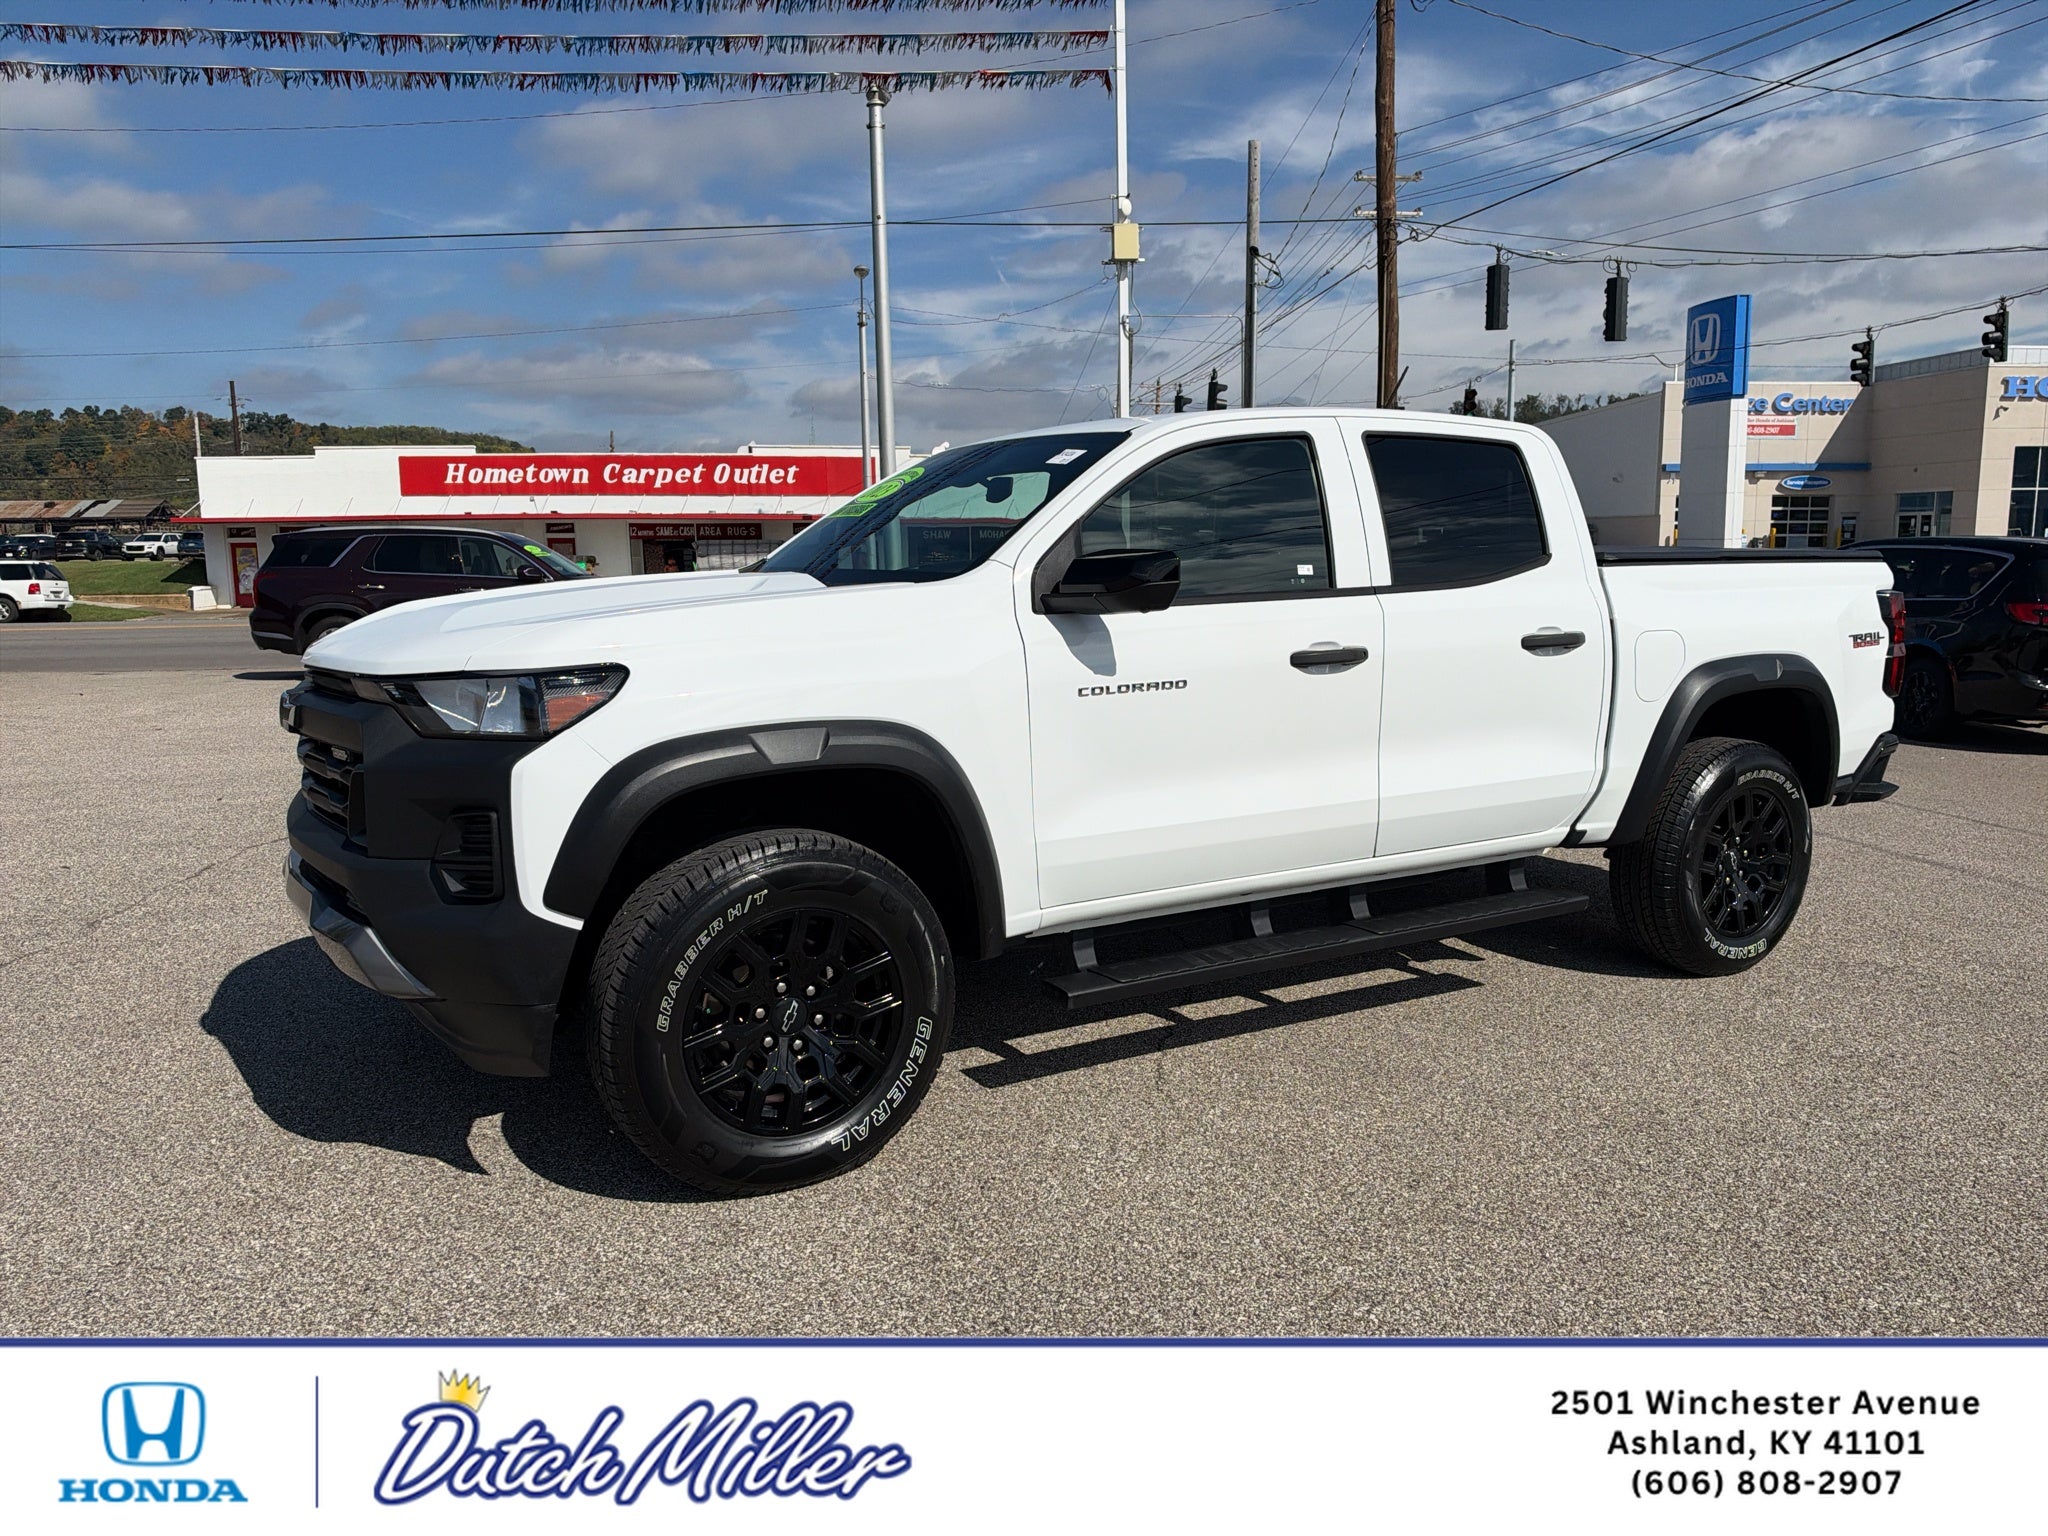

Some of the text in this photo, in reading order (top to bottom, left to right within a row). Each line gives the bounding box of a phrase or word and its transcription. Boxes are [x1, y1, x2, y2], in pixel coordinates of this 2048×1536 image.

[1774, 392, 1856, 413] Center
[444, 463, 799, 489] Hometown Carpet Outlet
[656, 526, 674, 536] SAME
[679, 526, 694, 536] CASH
[700, 526, 756, 536] AREA RUGS
[922, 530, 951, 540] SHAW
[1848, 631, 1885, 642] TRAIL
[1853, 640, 1880, 648] BOSS
[1077, 679, 1188, 697] COLORADO
[1704, 927, 1767, 959] GENERAL
[656, 889, 768, 1032] GRABBER H/T
[831, 1016, 933, 1151] GENERAL
